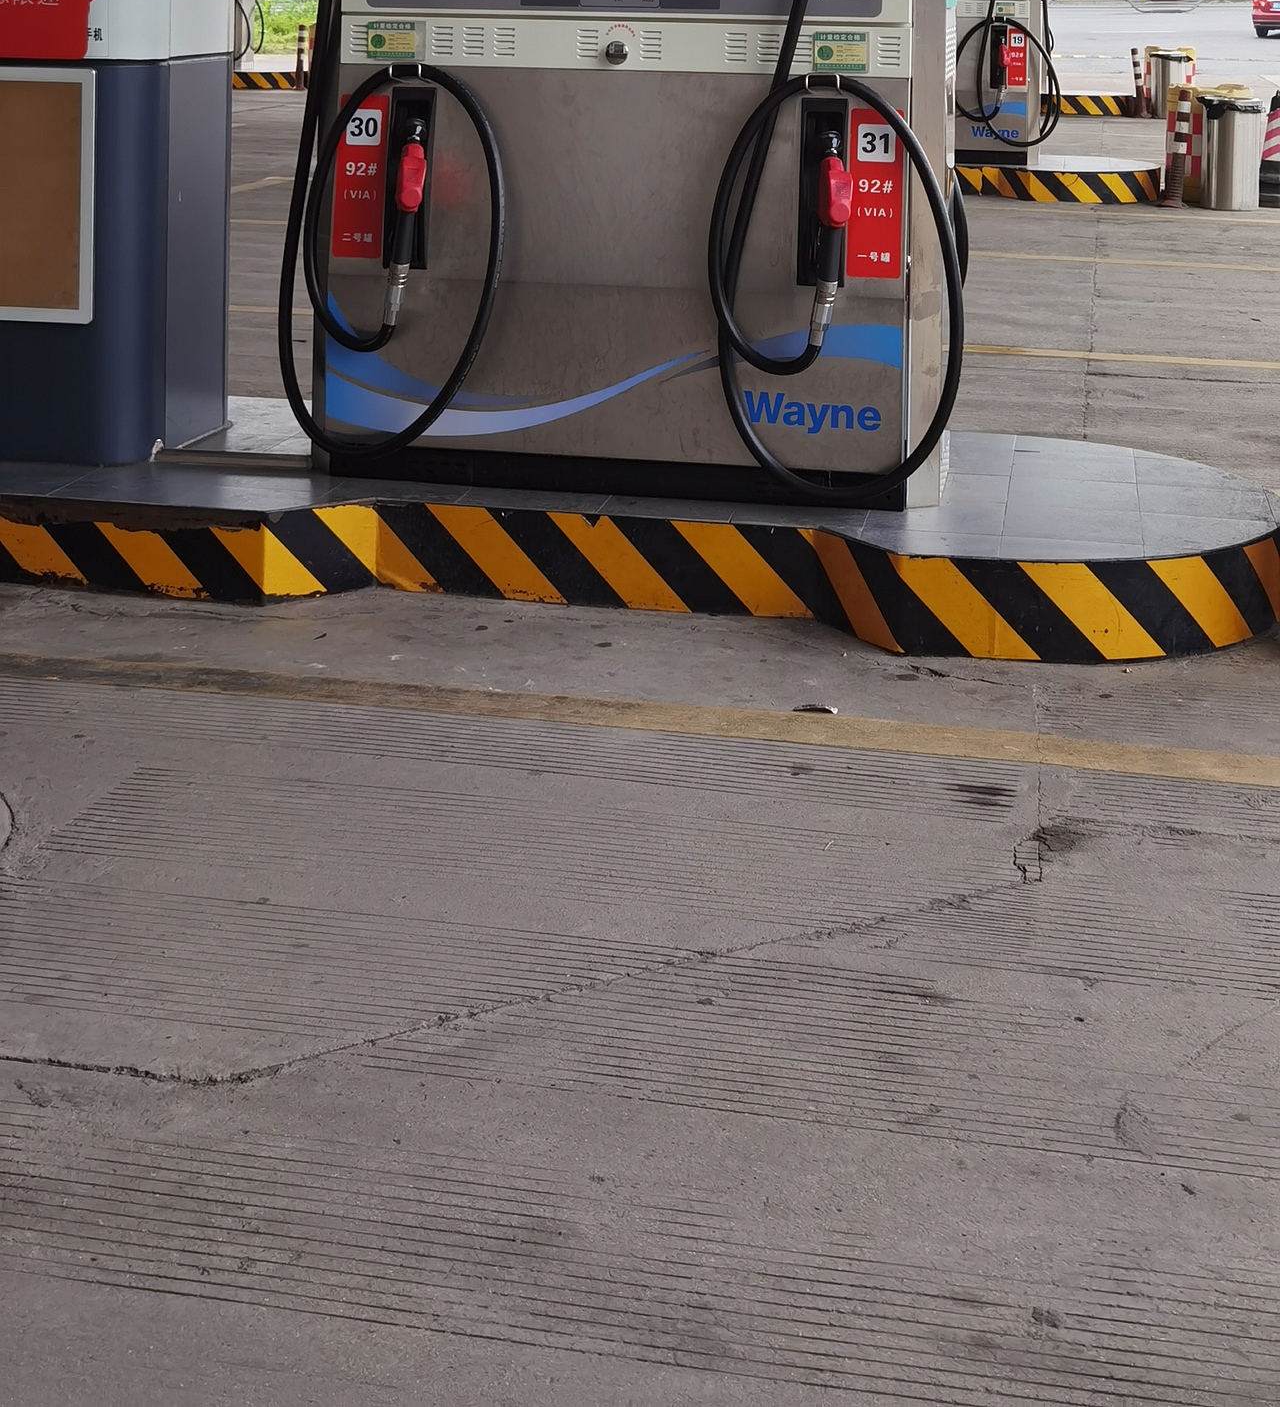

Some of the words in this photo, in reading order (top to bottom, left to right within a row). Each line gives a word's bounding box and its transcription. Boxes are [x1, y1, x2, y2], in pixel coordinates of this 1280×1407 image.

[374, 22, 411, 30] 计量检定合格
[820, 33, 861, 41] 计量检定合格
[1012, 35, 1023, 45] 19
[350, 117, 378, 138] 30
[861, 132, 890, 154] 31
[345, 162, 378, 176] 92#
[858, 178, 894, 194] 92#
[857, 252, 891, 263] 一号罐
[743, 390, 882, 435] Wayne
